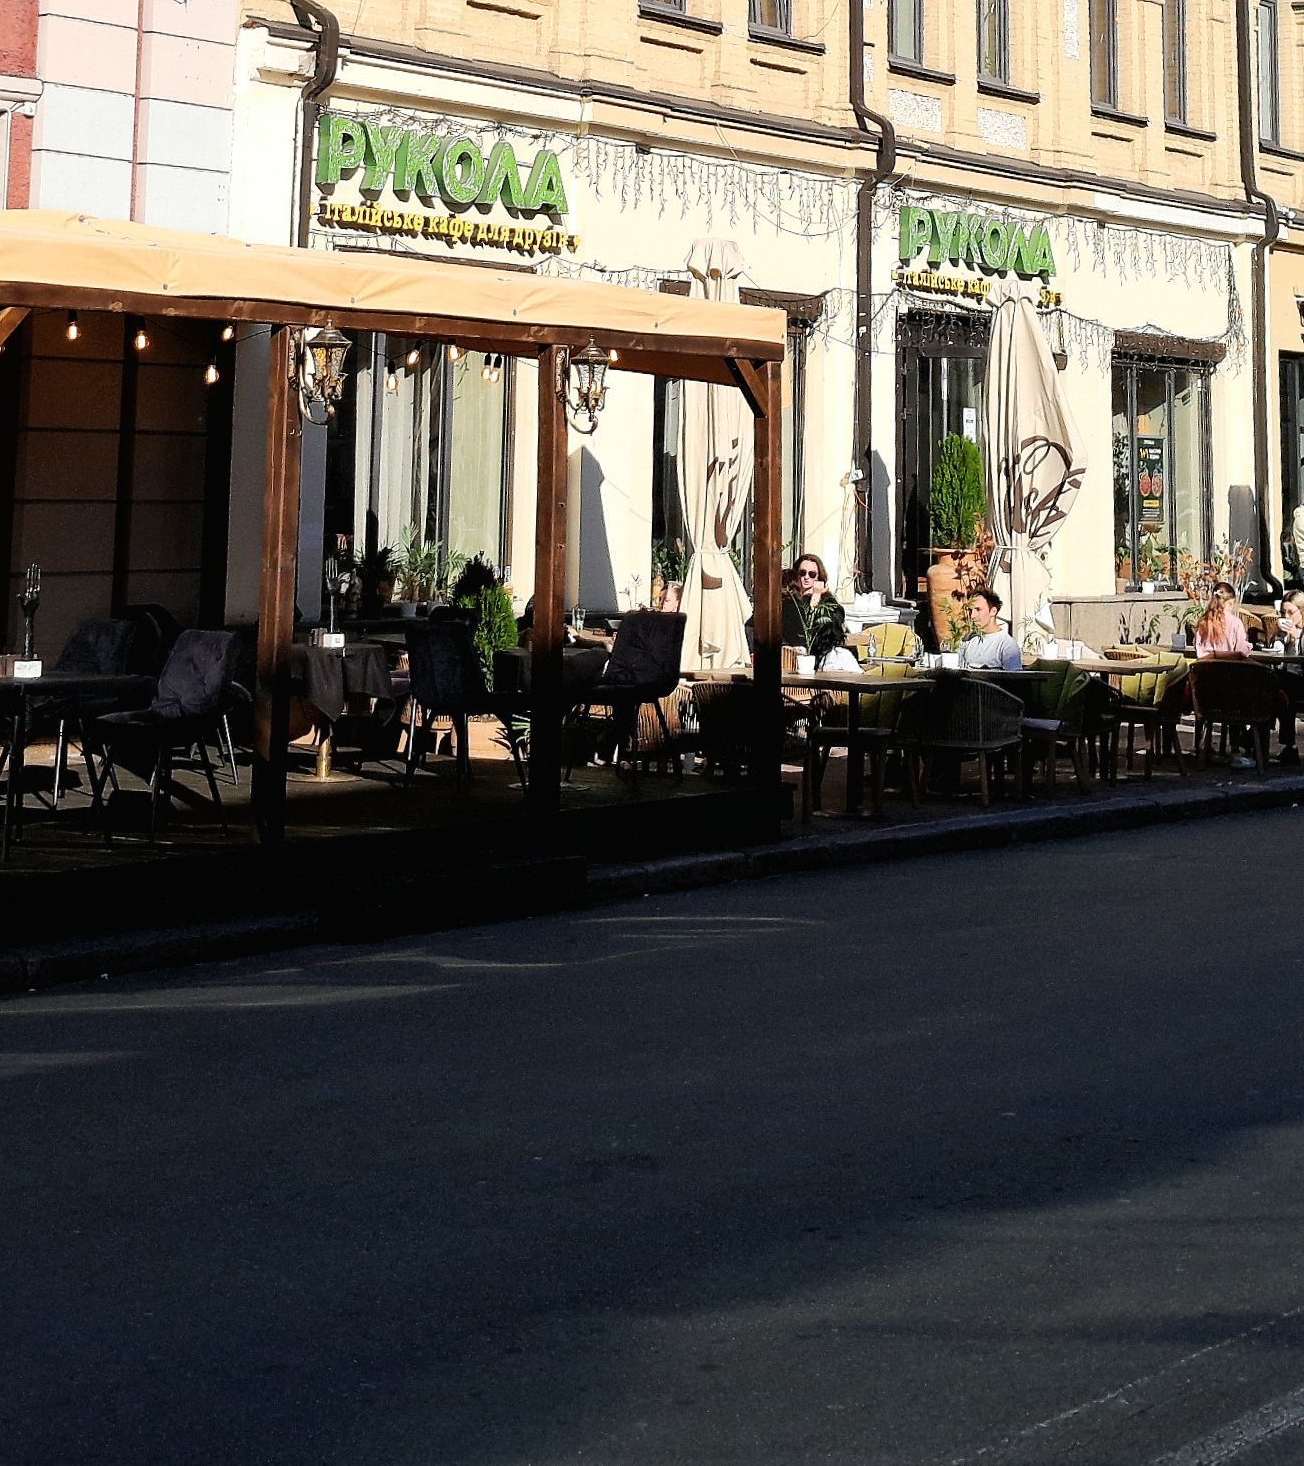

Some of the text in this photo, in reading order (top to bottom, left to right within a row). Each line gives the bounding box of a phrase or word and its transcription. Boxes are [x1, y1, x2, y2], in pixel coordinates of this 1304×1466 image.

[315, 114, 569, 215] РУКОЛА
[325, 202, 567, 250] італійське кафе для друзів
[899, 206, 1057, 277] РУКОЛА
[968, 278, 991, 297] каф
